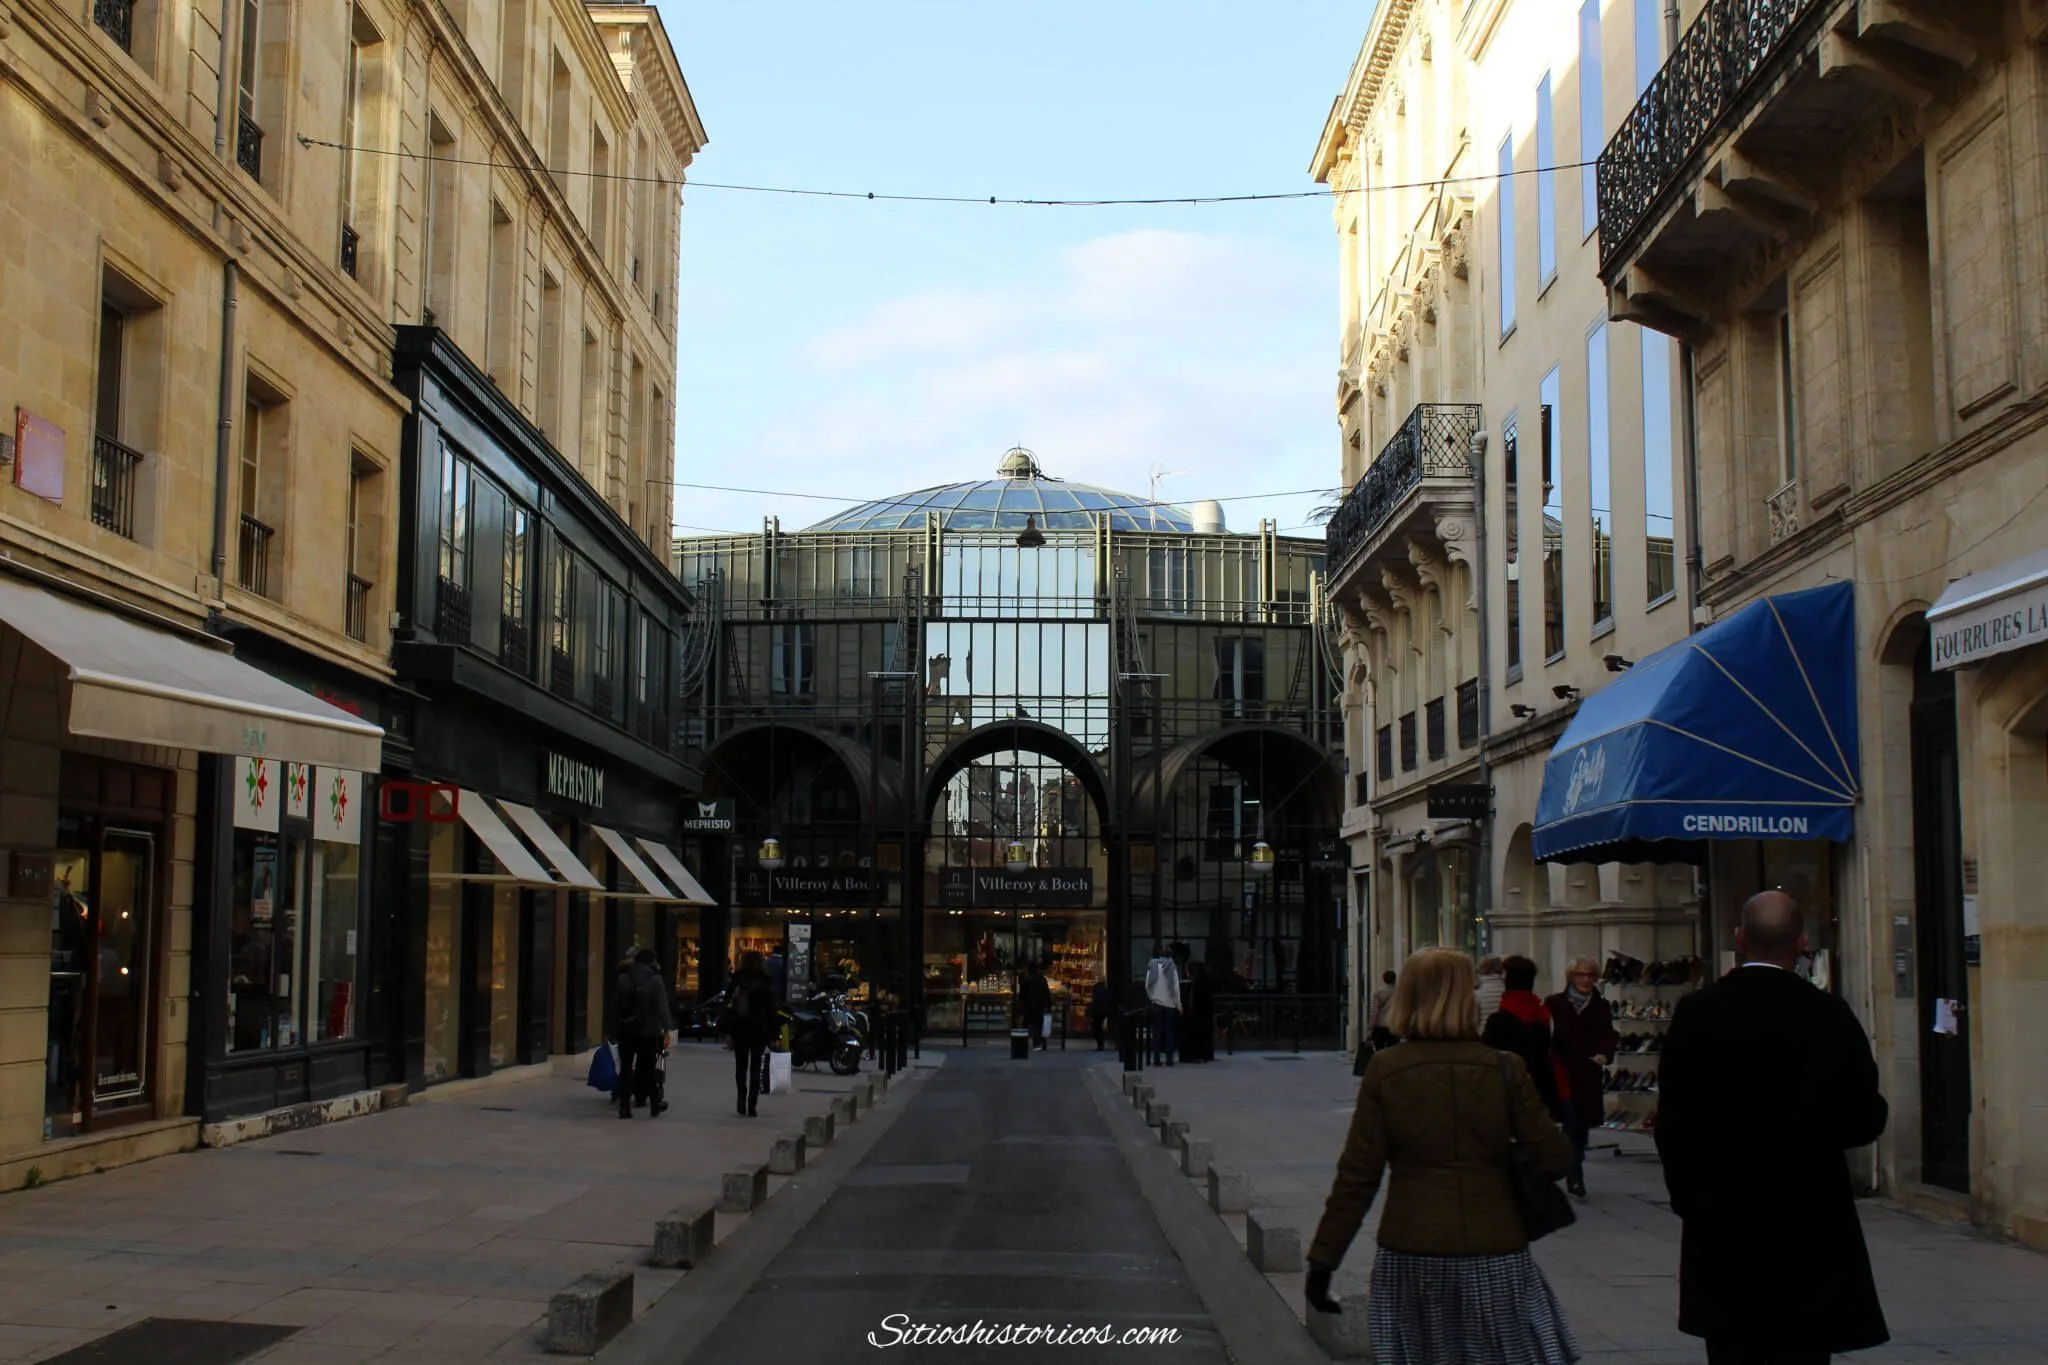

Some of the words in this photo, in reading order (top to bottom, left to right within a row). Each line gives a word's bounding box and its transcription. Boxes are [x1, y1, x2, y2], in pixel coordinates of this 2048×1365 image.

[1935, 610, 2022, 663] FOURRURES
[548, 751, 594, 807] MEPHISTO
[683, 818, 732, 830] MEPHISTO
[1682, 814, 1809, 834] CENDRILLON
[775, 876, 830, 893] Villeroy
[832, 878, 842, 891] &
[979, 876, 1036, 894] Villeroy
[1038, 879, 1049, 891] &
[1051, 876, 1089, 891] Boch
